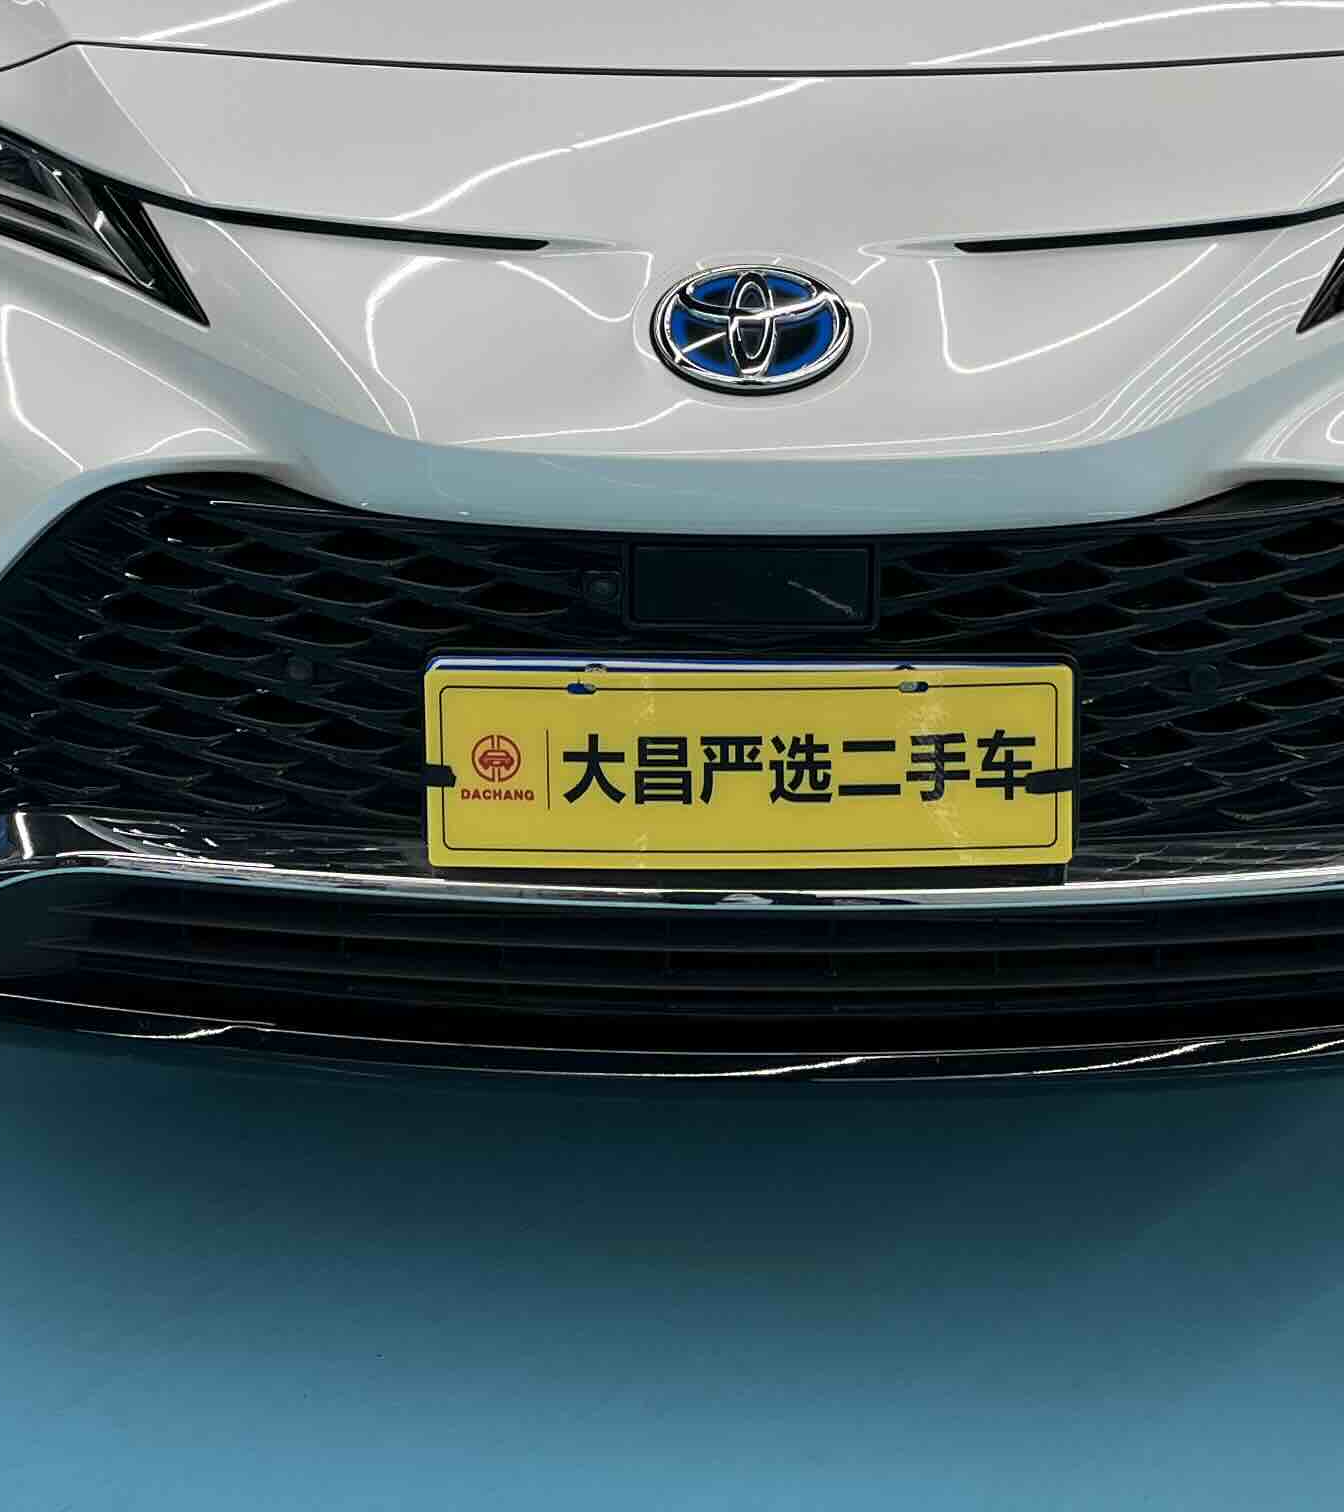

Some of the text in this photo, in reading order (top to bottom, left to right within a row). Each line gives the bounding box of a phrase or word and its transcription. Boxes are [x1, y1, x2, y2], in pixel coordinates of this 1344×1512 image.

[563, 729, 1036, 804] 大昌严选二手车
[461, 789, 535, 800] DACHANG
